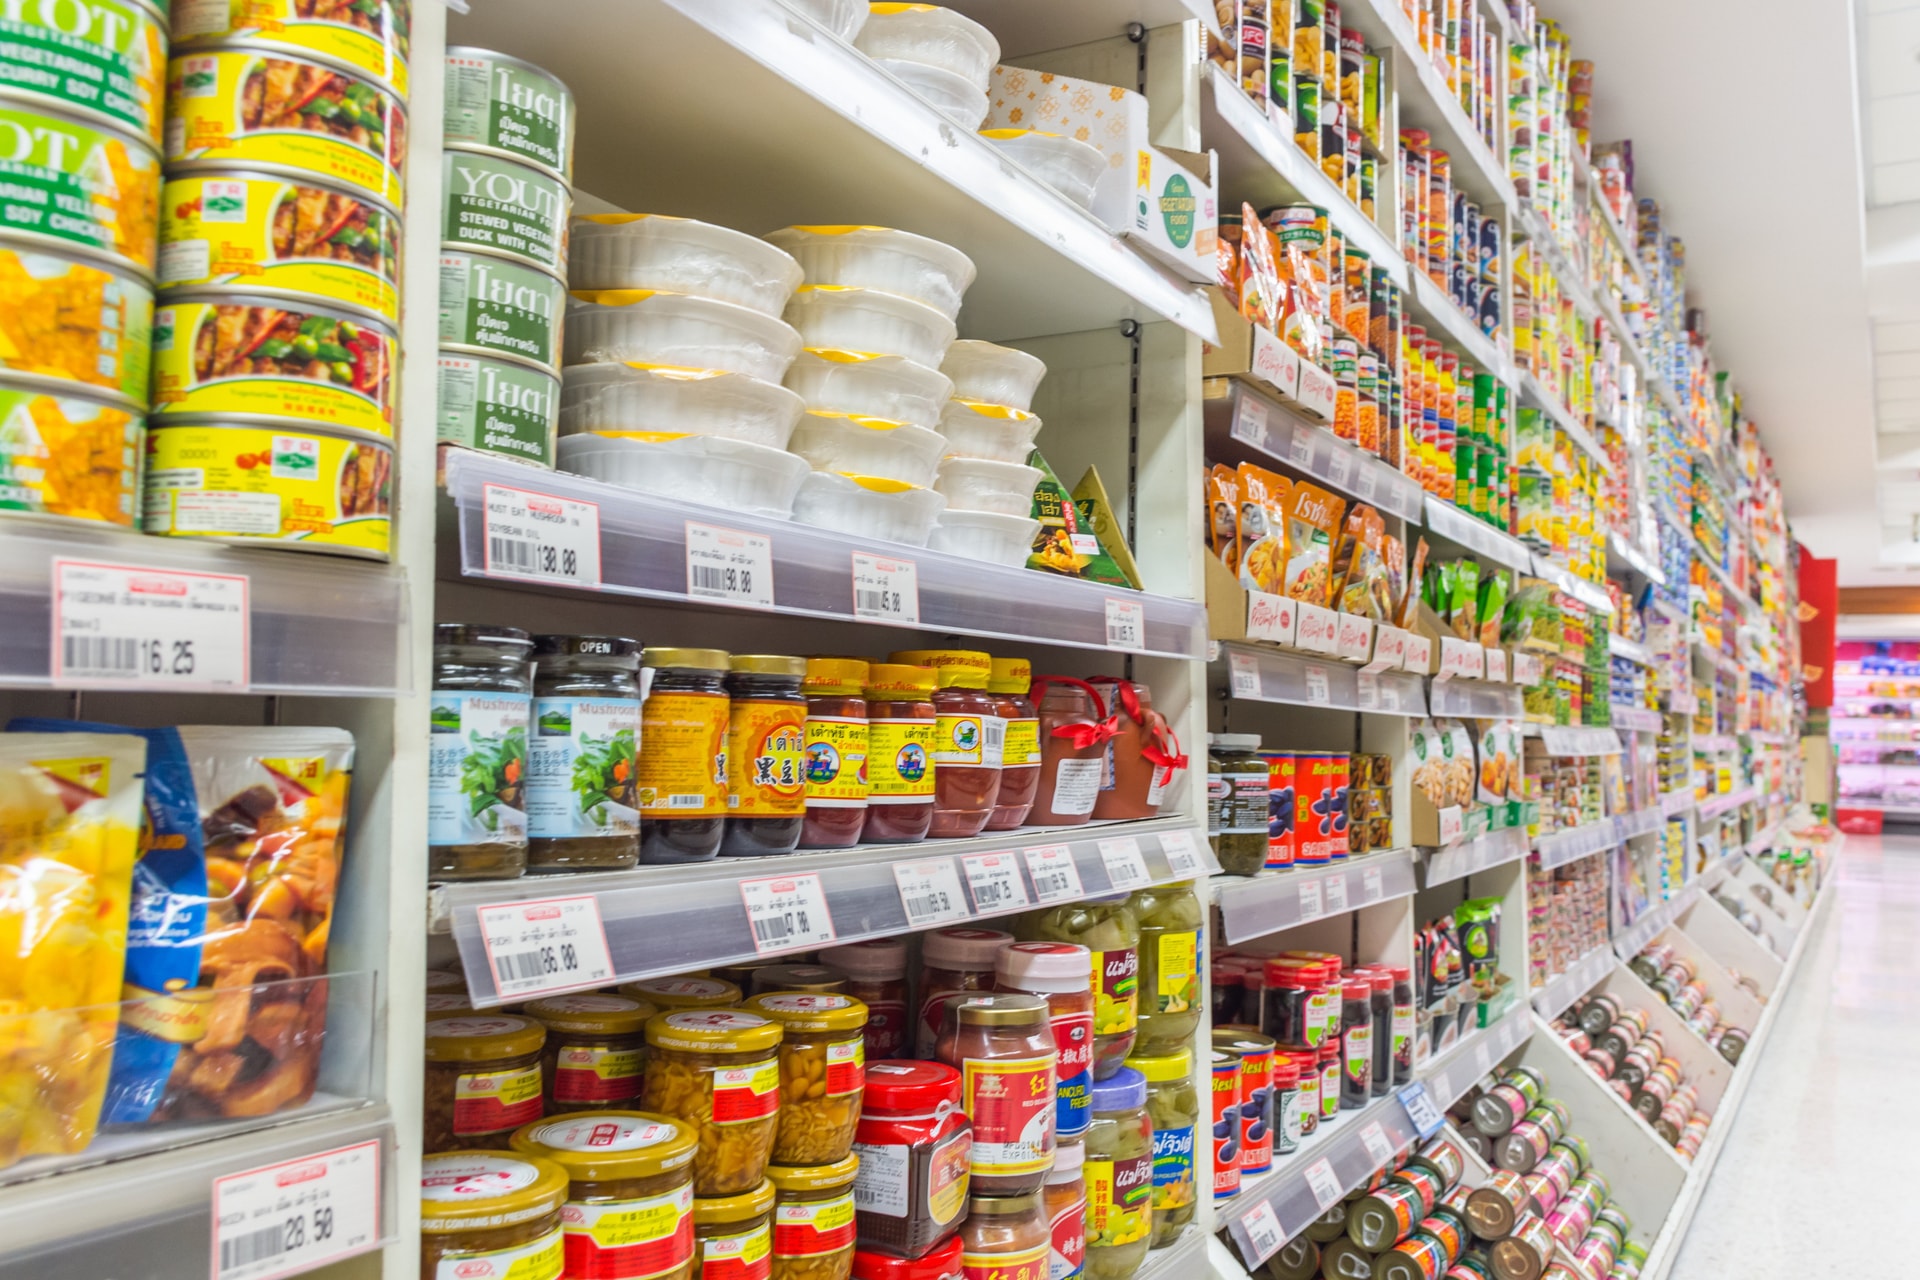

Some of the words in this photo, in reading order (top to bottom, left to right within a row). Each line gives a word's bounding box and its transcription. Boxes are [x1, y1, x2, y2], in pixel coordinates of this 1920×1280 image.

[66, 78, 99, 101] SOY
[5, 204, 43, 225] SOY
[460, 211, 509, 231] STEWED
[459, 227, 493, 242] DUCK
[497, 233, 526, 250] WITH
[141, 639, 195, 675] 16.25
[579, 641, 611, 654] OPEN
[285, 1206, 334, 1252] 28.50
